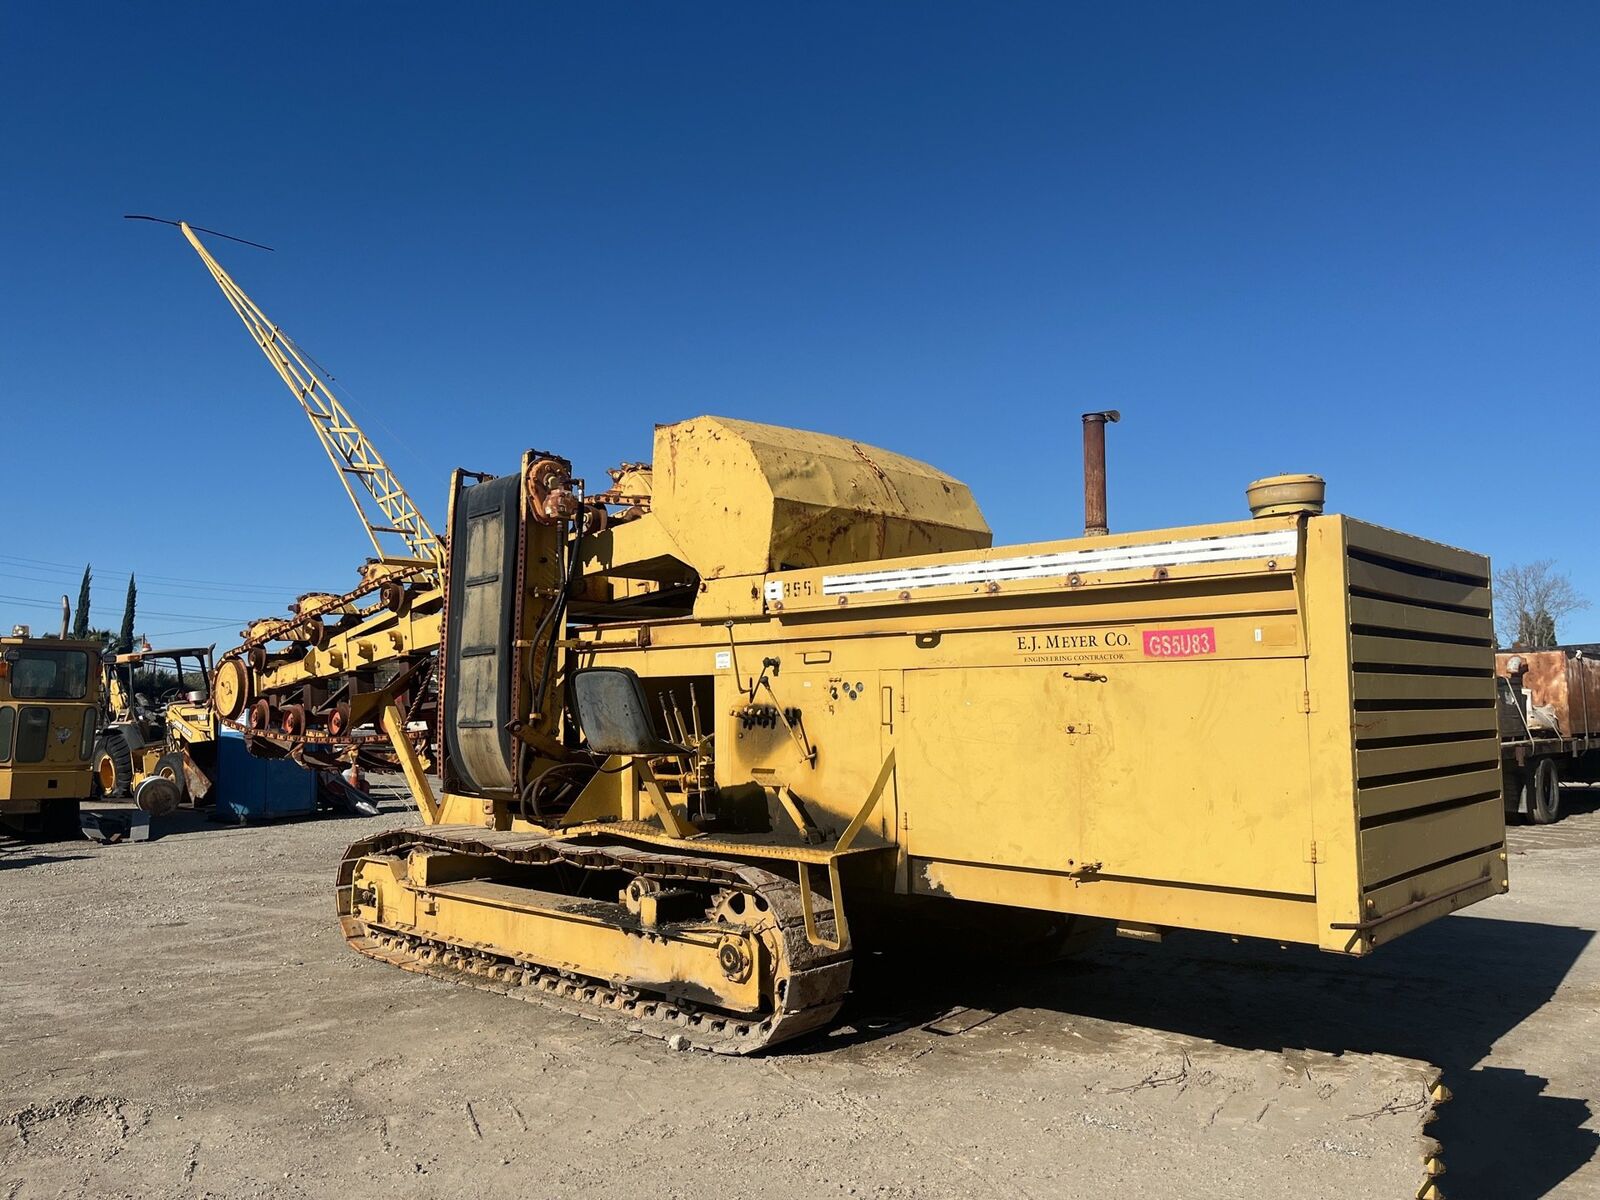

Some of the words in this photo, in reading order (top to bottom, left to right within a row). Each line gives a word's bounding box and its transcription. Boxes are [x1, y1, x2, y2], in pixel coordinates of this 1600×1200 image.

[1017, 636, 1041, 652] E.J.
[1046, 635, 1098, 649] MEYER
[1104, 631, 1131, 647] CO.
[1149, 632, 1210, 656] GS5U83
[1023, 655, 1073, 663] ENGINEERING
[1073, 653, 1125, 661] CONTRACTOR
